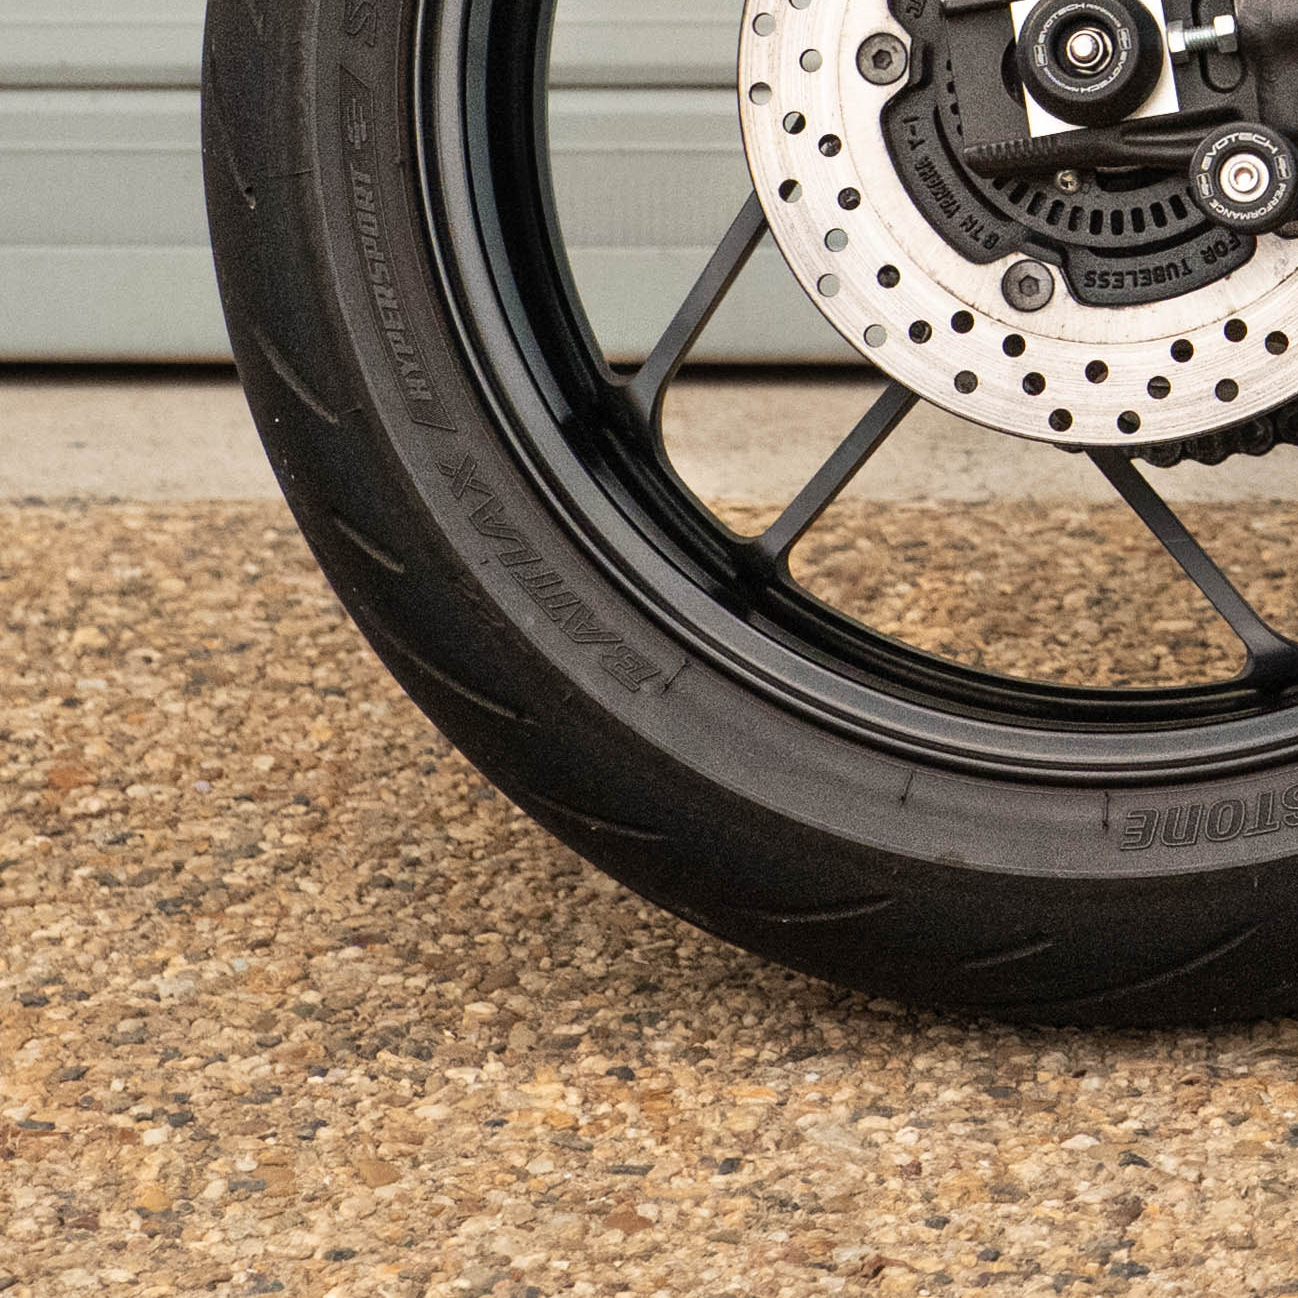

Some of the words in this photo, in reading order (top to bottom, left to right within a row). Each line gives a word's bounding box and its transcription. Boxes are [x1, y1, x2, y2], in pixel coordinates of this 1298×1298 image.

[1201, 132, 1278, 171] EVOTECH
[914, 155, 961, 219] YAMAHA
[1209, 183, 1287, 220] PERFORMANCE
[1200, 231, 1242, 265] FOR
[349, 158, 434, 403] HYPERSPORT
[1083, 258, 1193, 289] TUBELESS
[436, 451, 662, 693] BATTLAX
